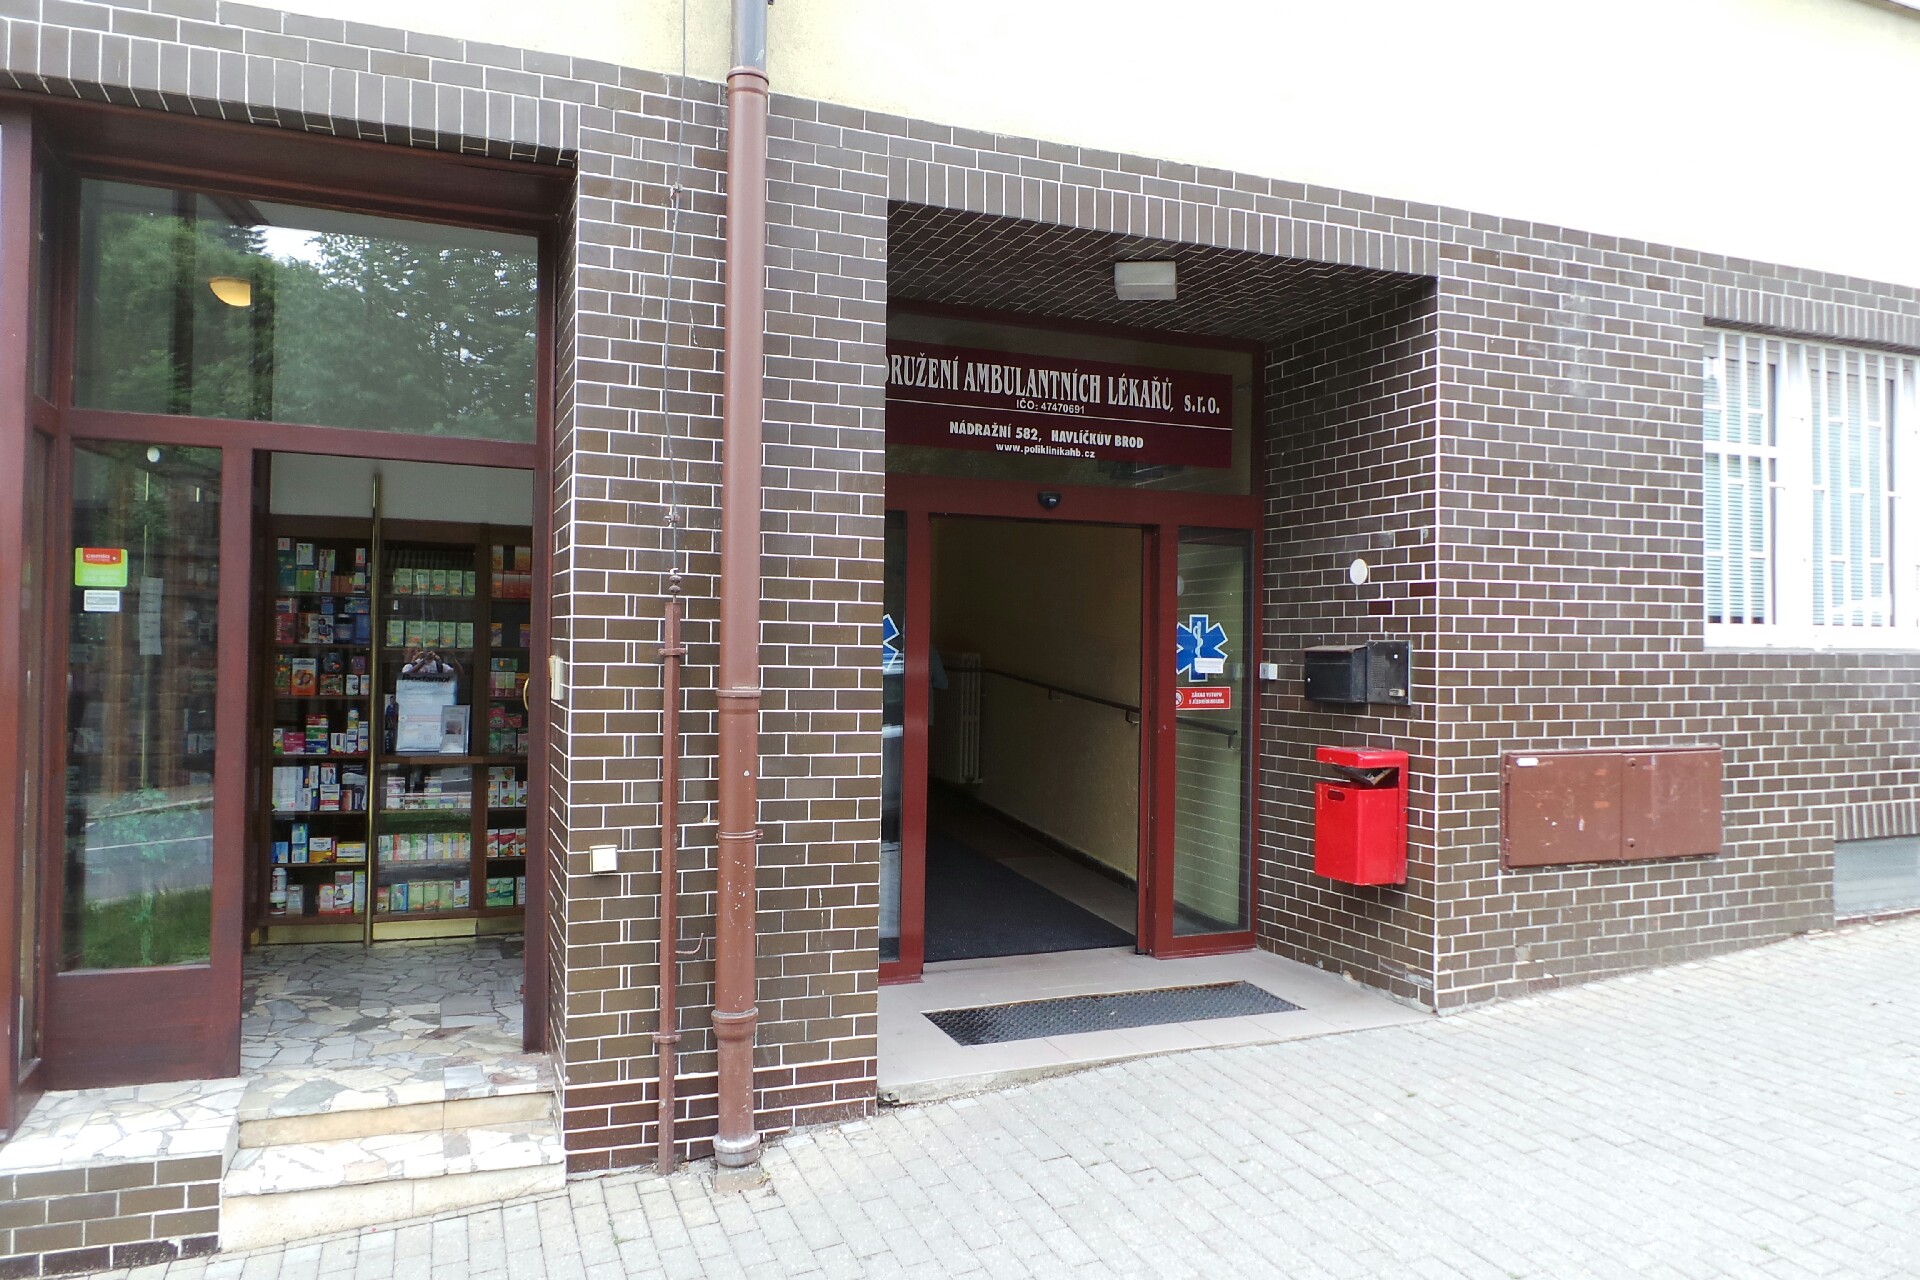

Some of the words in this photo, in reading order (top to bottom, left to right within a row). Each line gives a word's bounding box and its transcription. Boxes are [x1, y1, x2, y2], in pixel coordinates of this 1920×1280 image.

[963, 362, 1100, 404] AMBULANTNÍCH
[1108, 373, 1174, 412] LÉKAŘŮ,
[1184, 394, 1220, 414] s.r.o.
[1016, 398, 1038, 411] IČO:
[1040, 401, 1085, 414] 47470691
[949, 420, 1011, 438] NÁDRAŽNÍ
[1015, 426, 1042, 442] 582,
[1051, 429, 1112, 446] HAVLÍČKŮV
[1114, 434, 1144, 449] BROD
[995, 442, 1096, 459] www.poliklinikahb.cz
